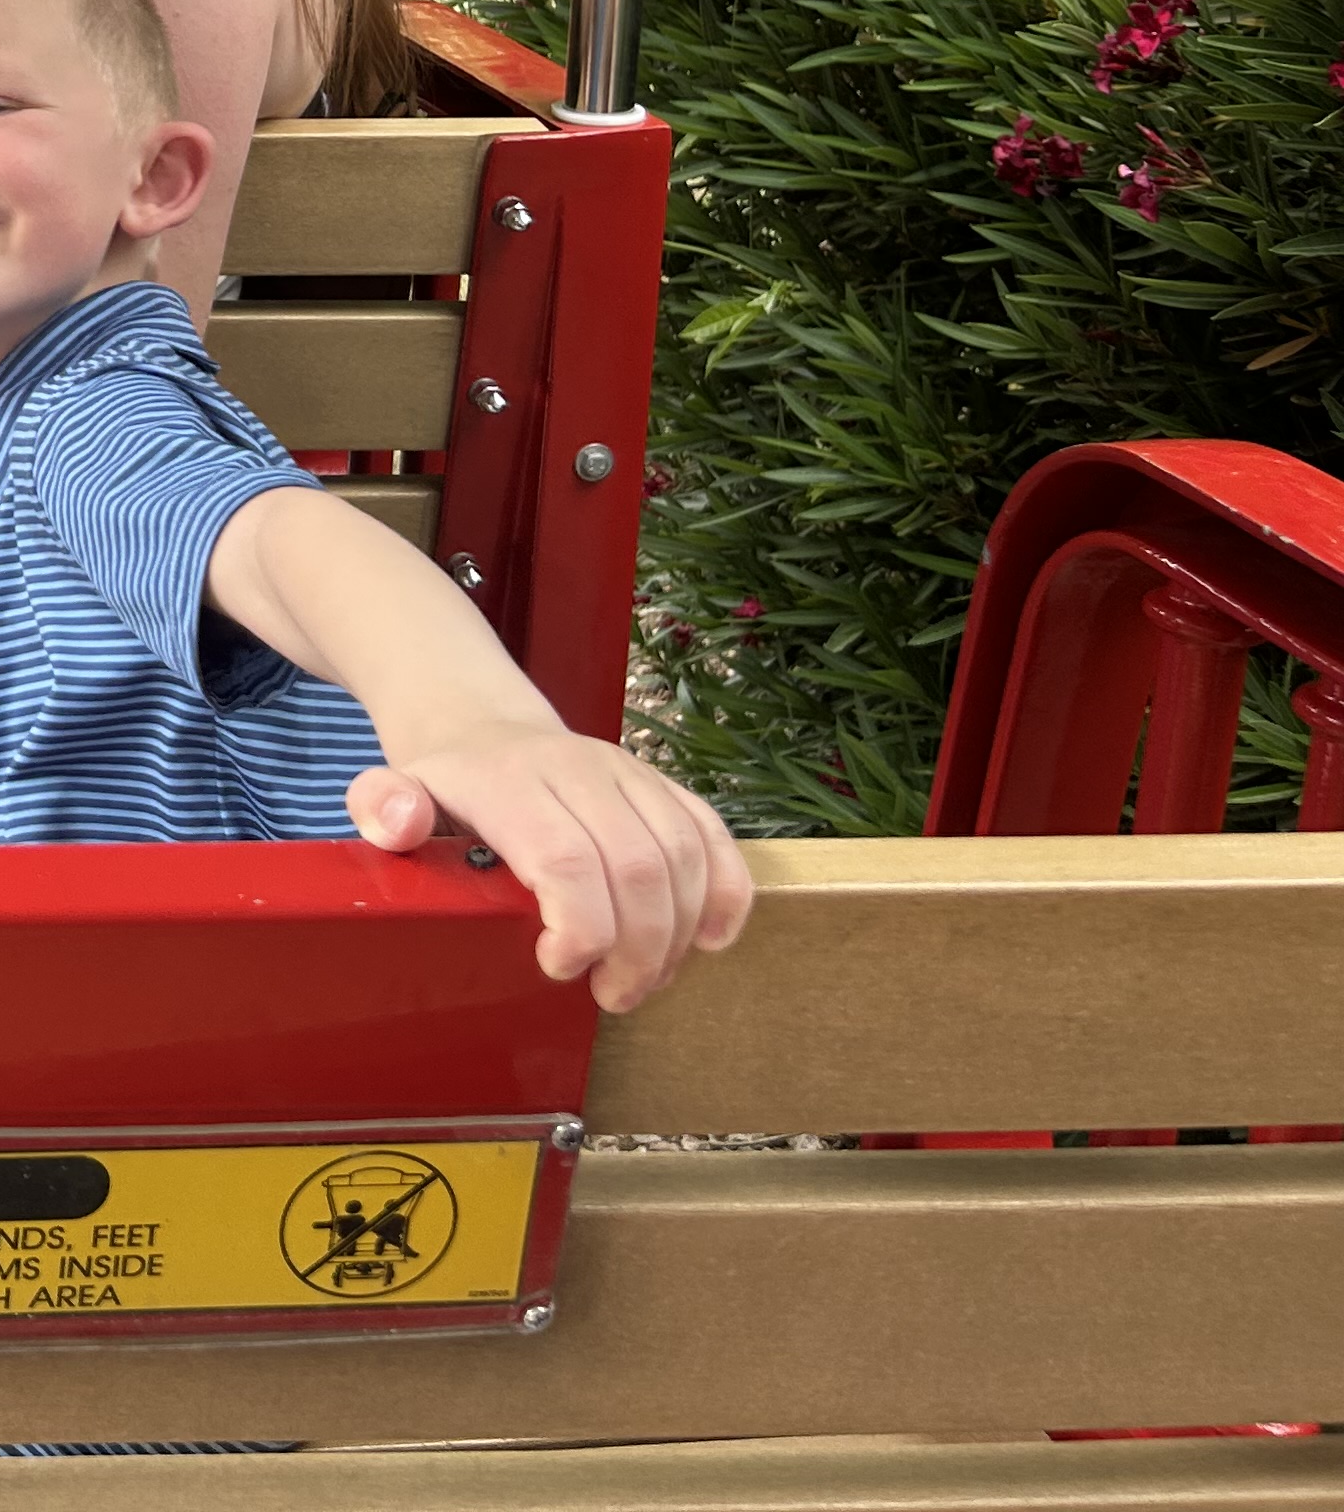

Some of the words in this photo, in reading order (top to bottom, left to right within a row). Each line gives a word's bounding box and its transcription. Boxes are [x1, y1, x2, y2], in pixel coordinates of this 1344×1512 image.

[91, 1223, 161, 1248] FEET
[58, 1253, 164, 1279] INSIDE
[29, 1284, 122, 1308] AREA
